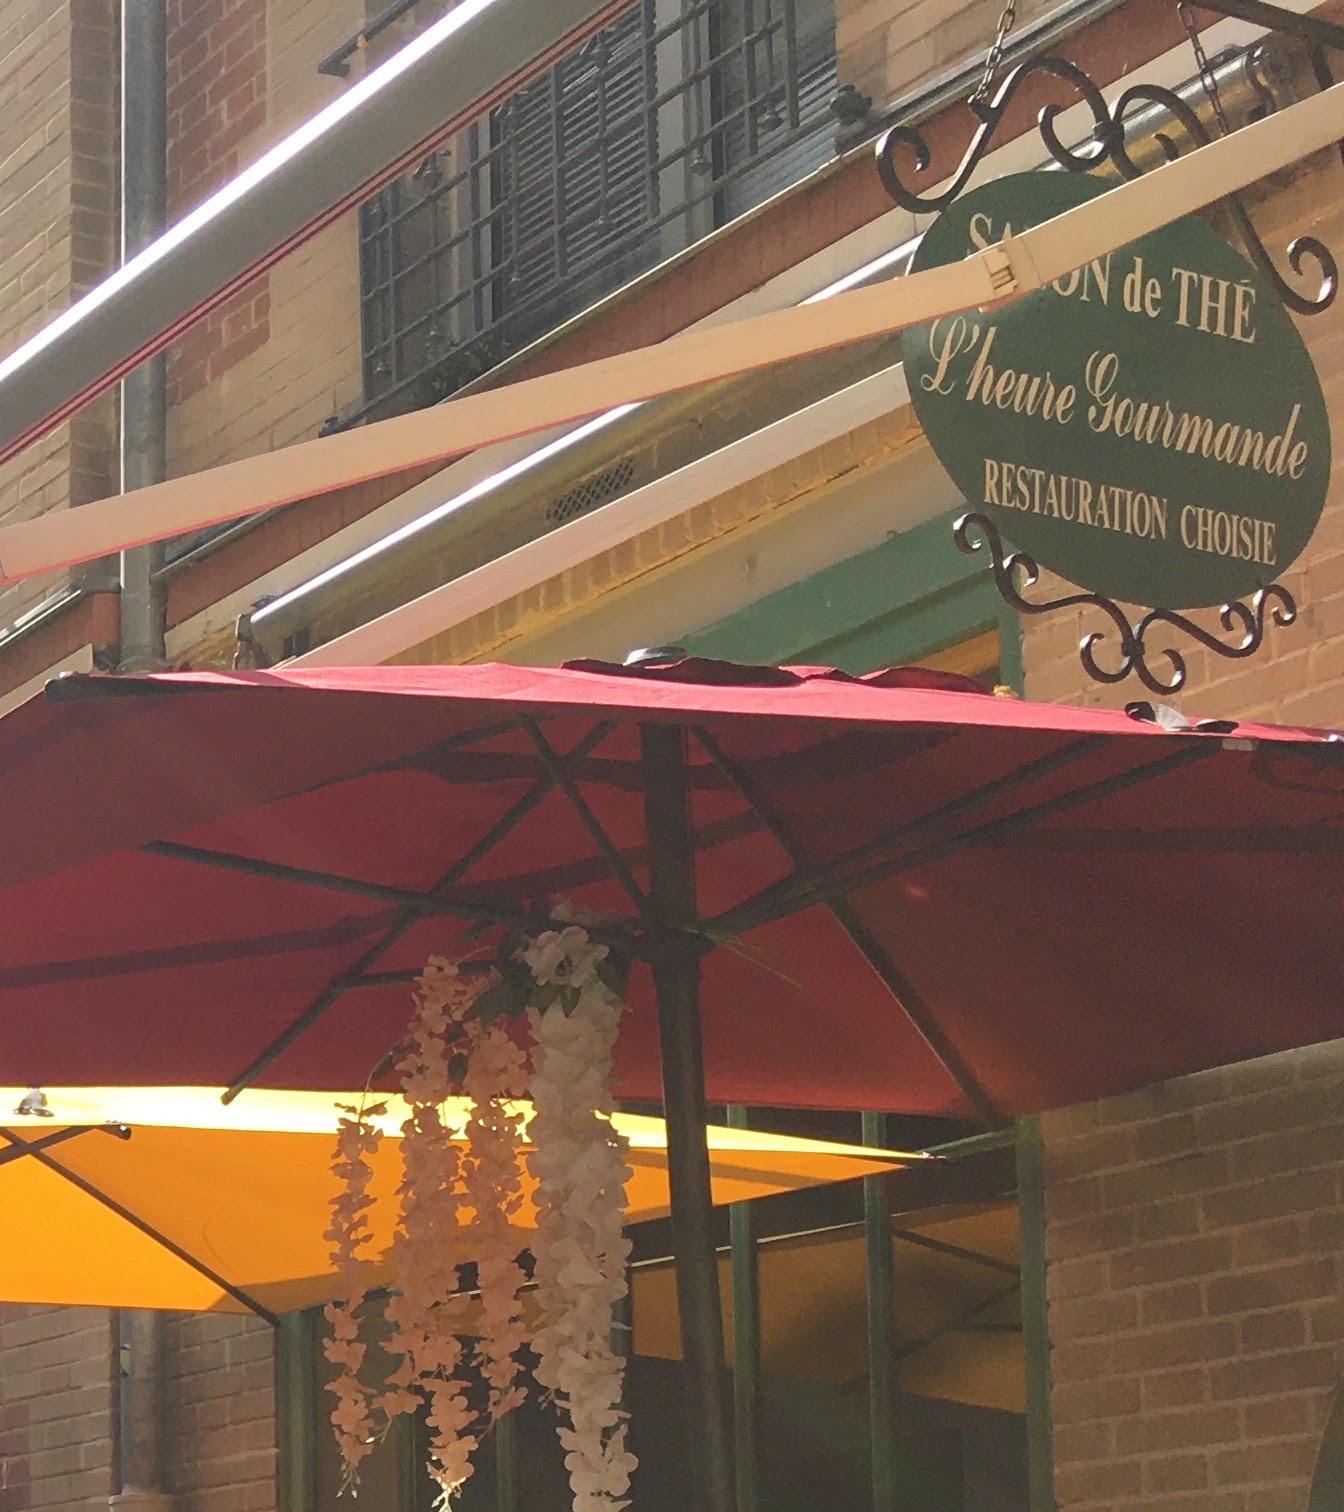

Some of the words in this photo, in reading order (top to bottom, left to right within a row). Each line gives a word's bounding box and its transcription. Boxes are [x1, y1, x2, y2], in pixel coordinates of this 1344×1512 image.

[1123, 256, 1162, 318] de
[1171, 266, 1256, 344] THÉ
[919, 315, 1077, 424] L'heure
[1085, 350, 1308, 480] Gourmande
[983, 458, 1168, 541] RESTAURATION
[1180, 504, 1277, 567] CHOISIE
